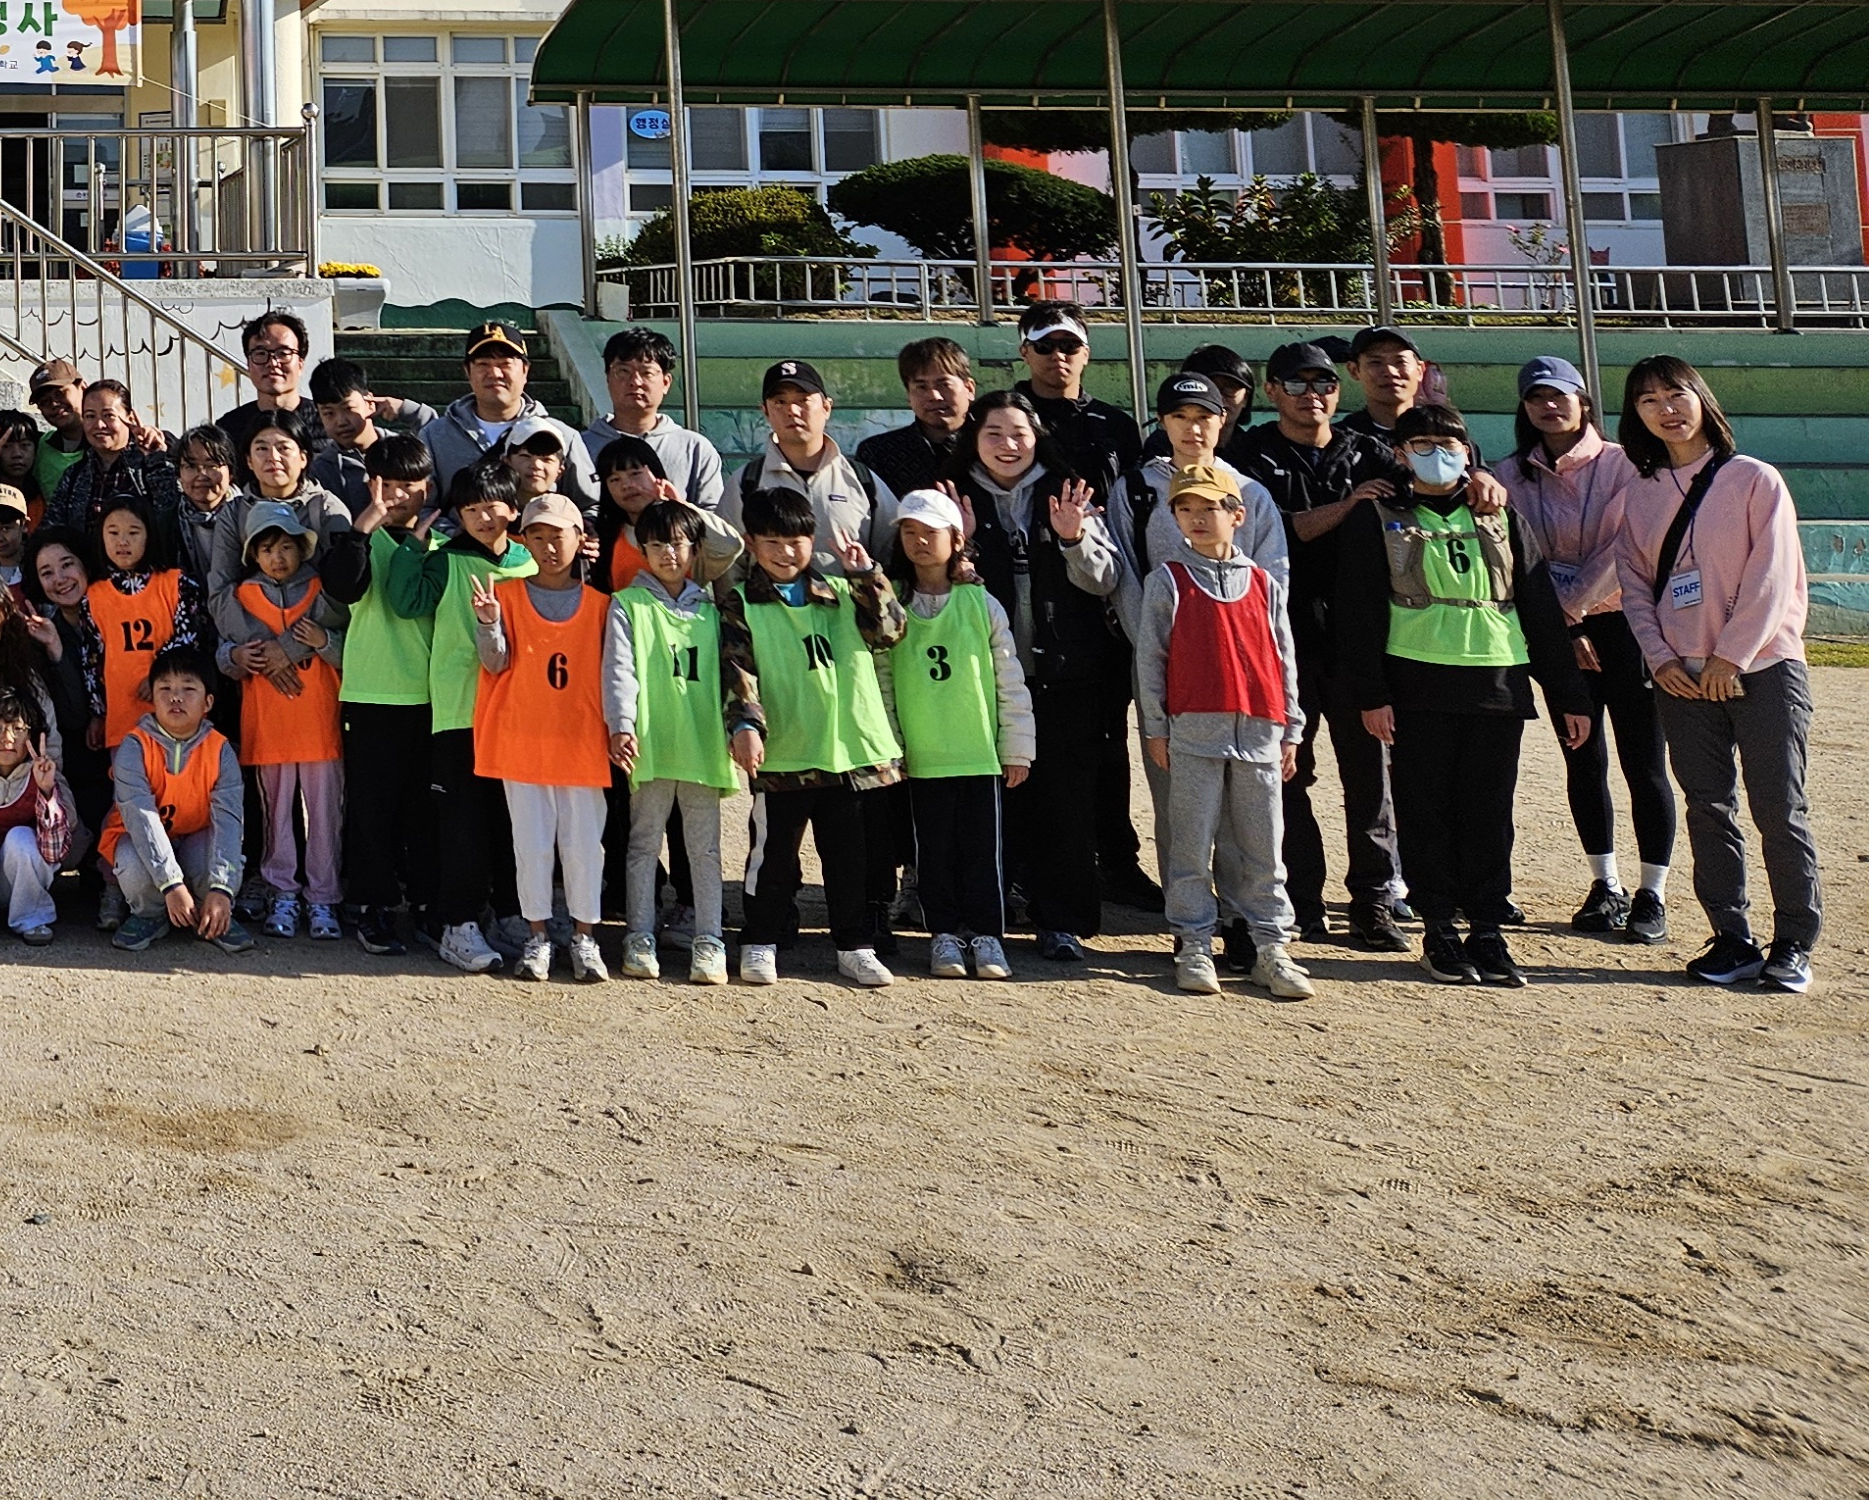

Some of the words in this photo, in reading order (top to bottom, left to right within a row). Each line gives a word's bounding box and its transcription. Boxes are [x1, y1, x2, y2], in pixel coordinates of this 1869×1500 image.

[484, 322, 508, 341] LA
[781, 362, 797, 376] S
[1446, 538, 1471, 574] 6
[1672, 581, 1700, 598] STAFF
[121, 618, 154, 652] 12
[802, 634, 836, 672] 10
[547, 652, 569, 691] 6
[668, 644, 701, 683] 11
[926, 645, 952, 681] 3
